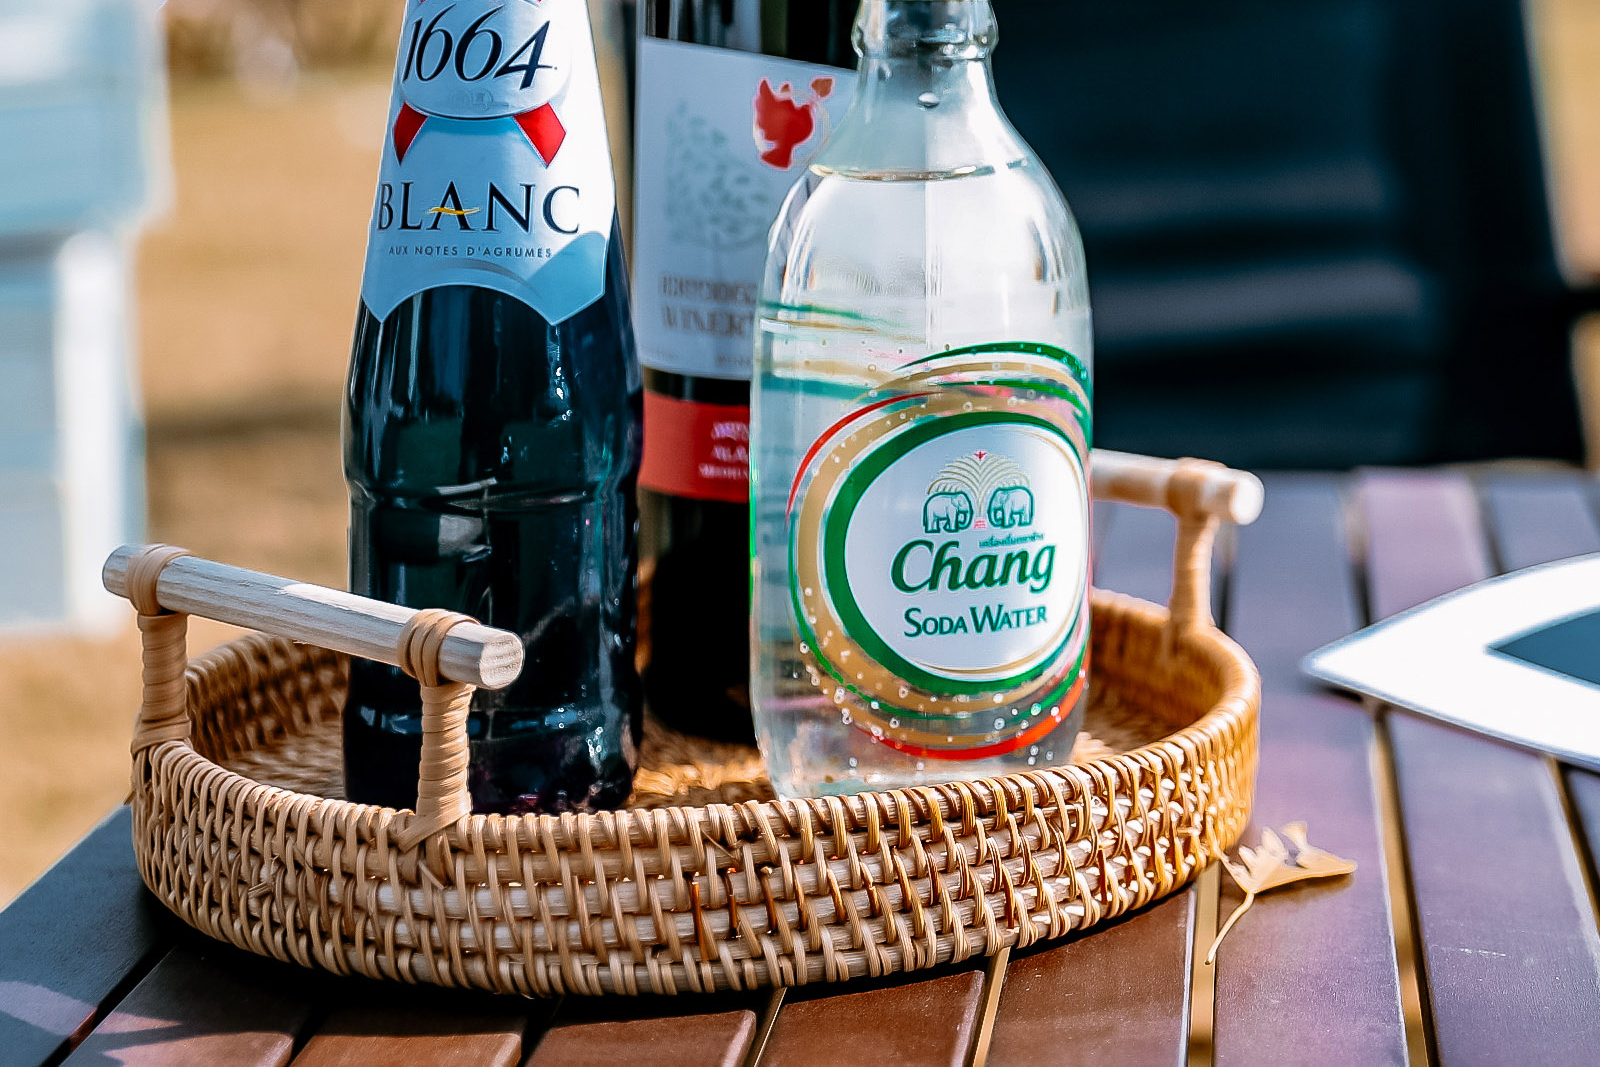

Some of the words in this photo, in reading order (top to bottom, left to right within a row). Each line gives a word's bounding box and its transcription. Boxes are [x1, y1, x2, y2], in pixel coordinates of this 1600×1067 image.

[402, 3, 552, 91] 1664
[376, 180, 581, 236] BLANC
[388, 245, 409, 256] AUX
[414, 245, 459, 256] NOTES
[466, 246, 552, 259] D'AGRUMES
[891, 539, 1057, 594] Chang
